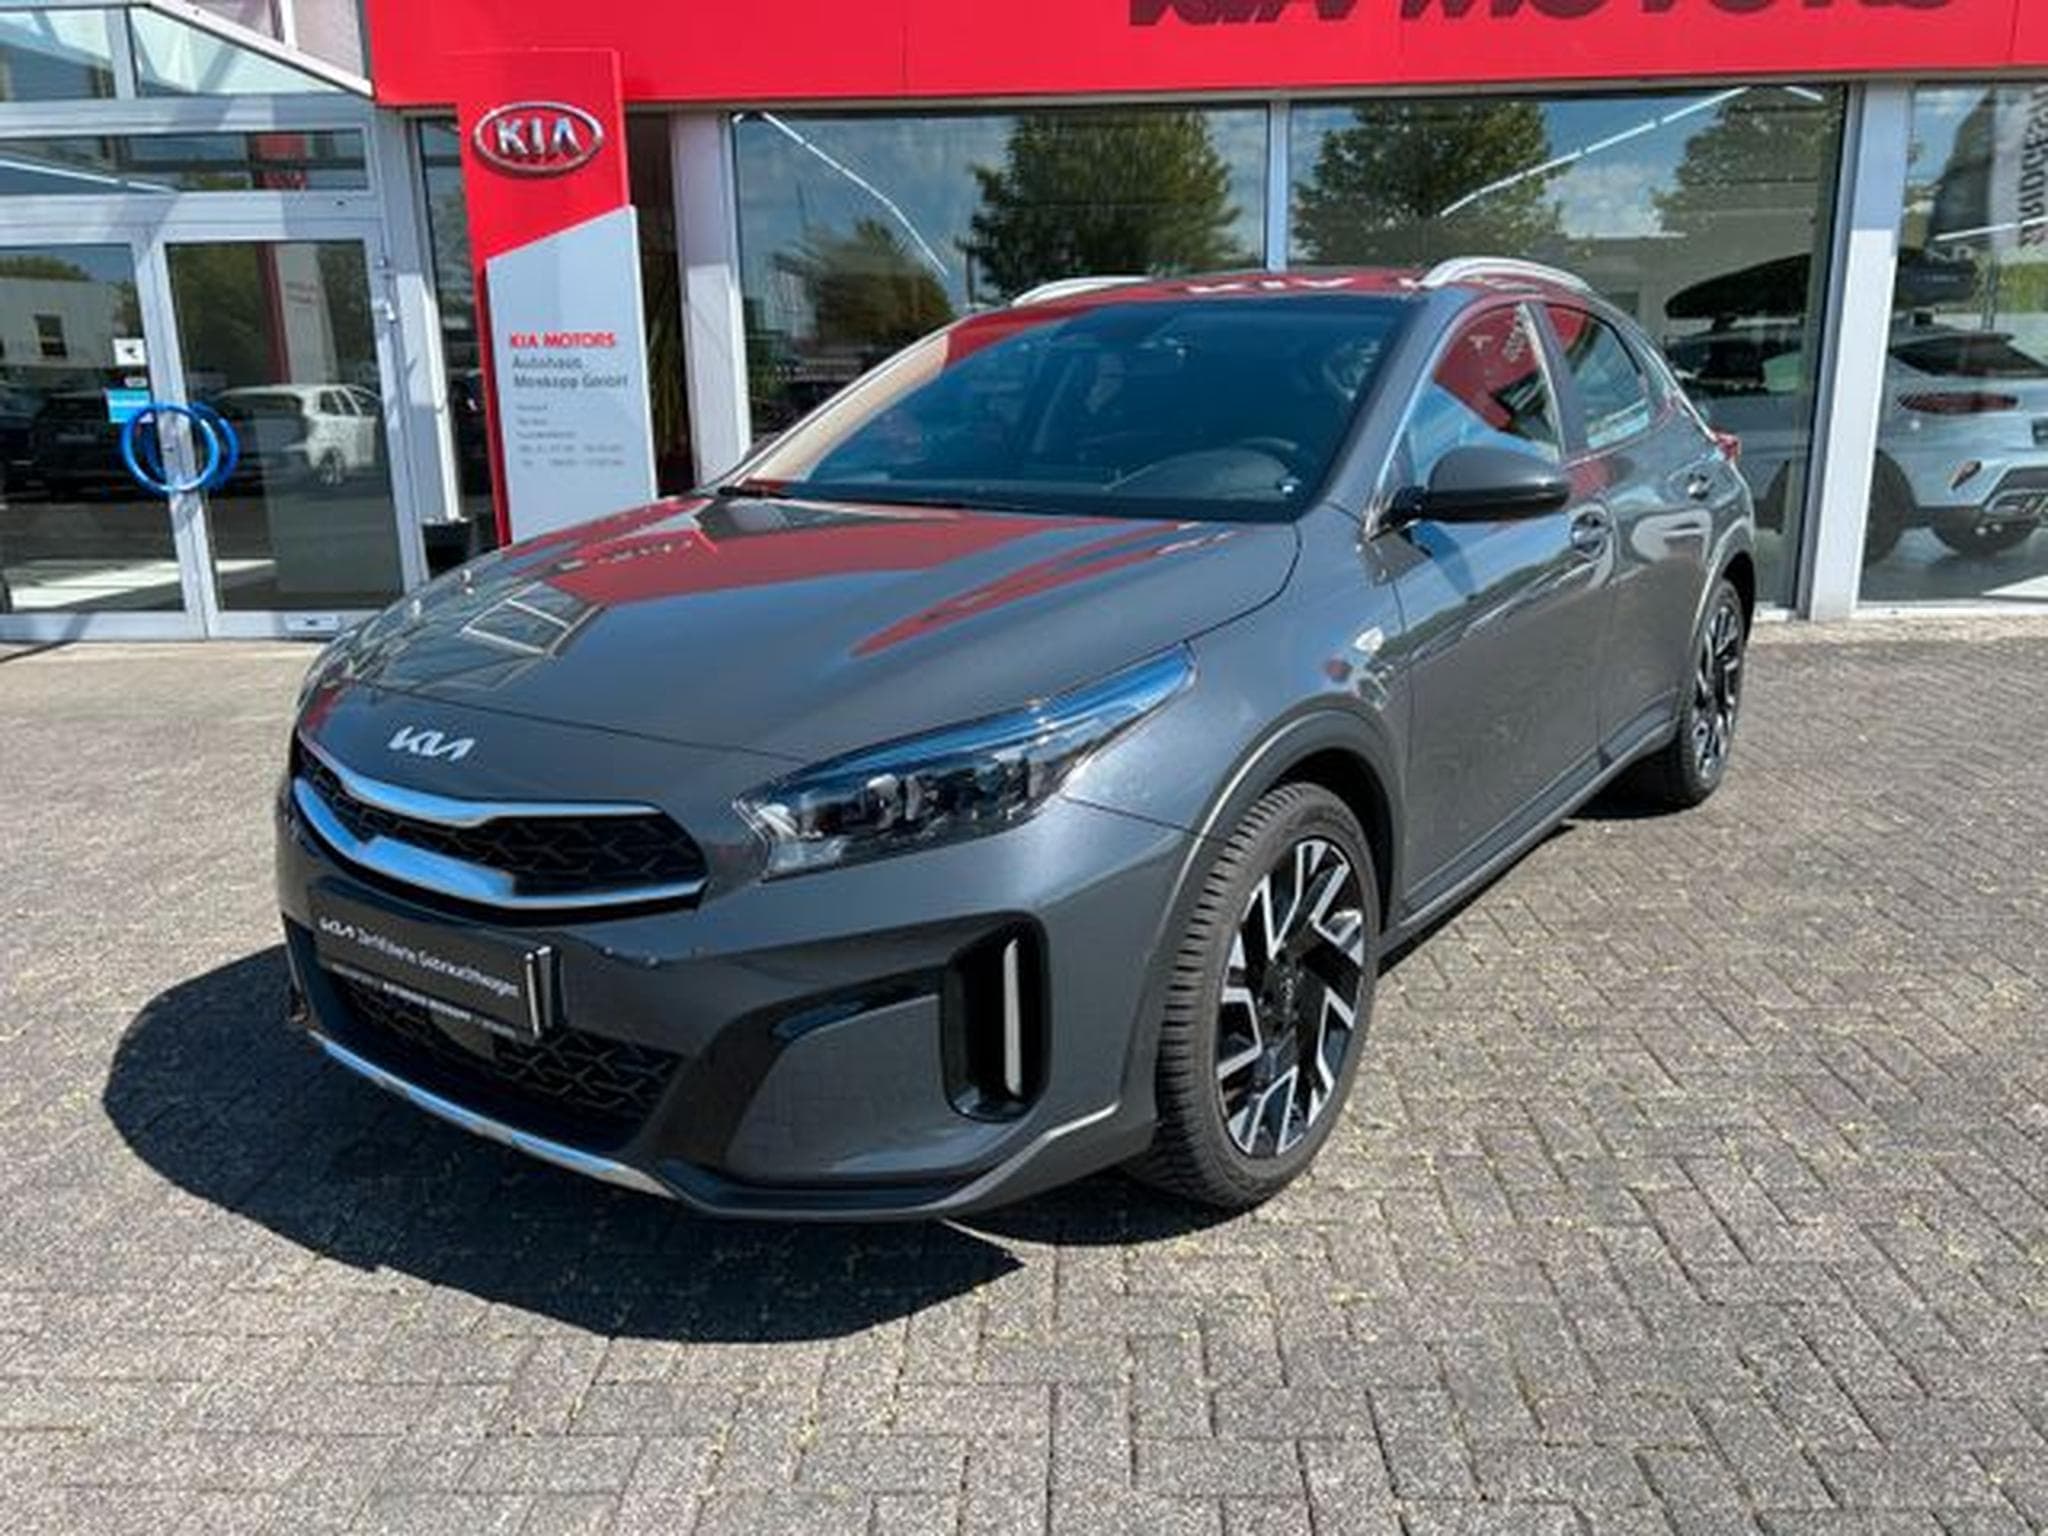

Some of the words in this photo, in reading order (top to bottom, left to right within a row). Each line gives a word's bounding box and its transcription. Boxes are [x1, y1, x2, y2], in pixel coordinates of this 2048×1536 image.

[496, 116, 584, 155] KIA
[511, 332, 538, 349] KIA
[543, 332, 616, 349] MOTORS
